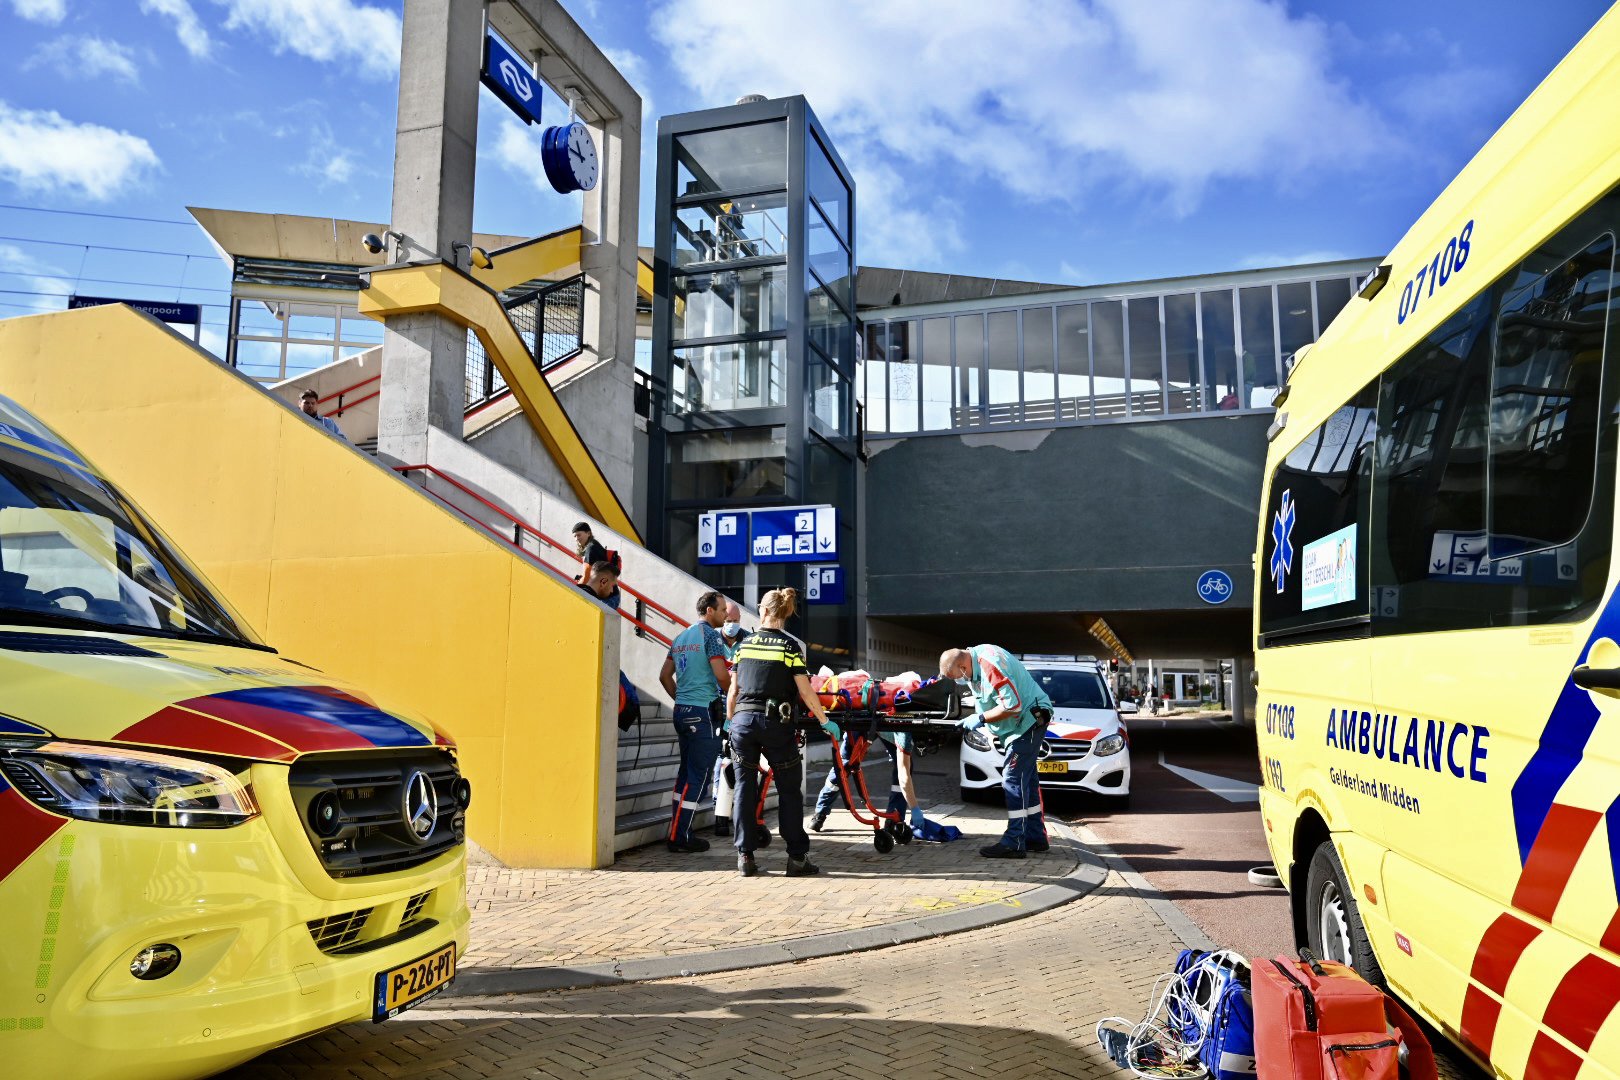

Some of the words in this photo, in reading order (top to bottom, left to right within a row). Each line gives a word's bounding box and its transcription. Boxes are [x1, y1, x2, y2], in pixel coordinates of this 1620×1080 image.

[1398, 219, 1474, 325] 07108
[724, 523, 731, 533] 1
[800, 519, 808, 530] 2
[1266, 703, 1295, 741] 07108
[1038, 762, 1064, 772] 79-PD
[1326, 708, 1491, 783] AMBULANCE
[1330, 766, 1378, 799] Gelderland
[1380, 782, 1421, 814] Midden
[393, 950, 451, 1003] P-226-PT
